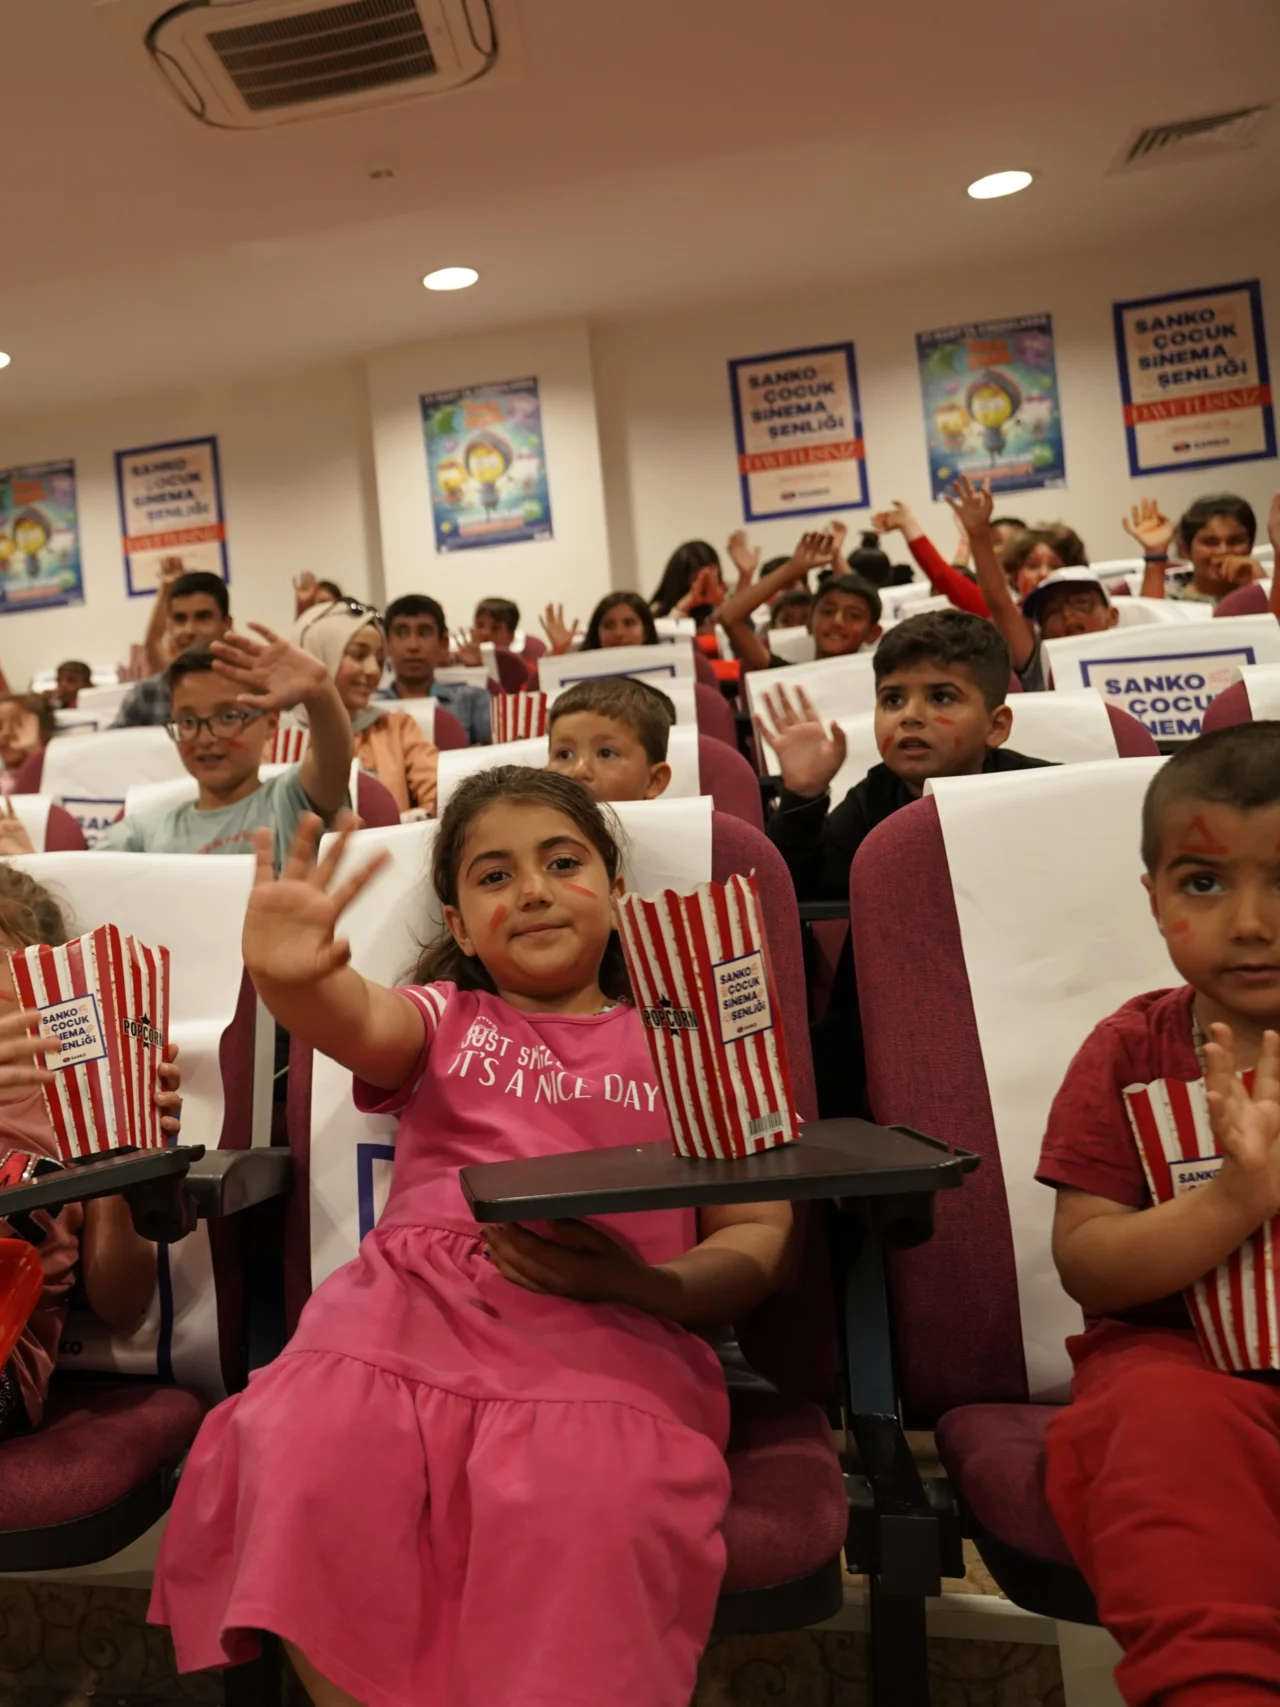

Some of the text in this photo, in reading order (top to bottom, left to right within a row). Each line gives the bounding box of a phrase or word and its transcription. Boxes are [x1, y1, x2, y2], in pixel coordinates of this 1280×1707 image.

[1135, 308, 1215, 334] SANKO
[1153, 322, 1237, 350] ÇOCUK
[748, 366, 817, 389] SANKO
[764, 382, 835, 404] ÇOCUK
[1105, 674, 1205, 695] SANKO
[1128, 695, 1217, 719] ÇOCU
[720, 966, 752, 985] SANKO
[728, 977, 761, 996] ÇOCUK
[42, 1007, 78, 1025] SANKO
[51, 1014, 90, 1035] ÇOCUK
[644, 1009, 698, 1028] POPCORN
[123, 1019, 164, 1048] POPCORN
[461, 1027, 513, 1057] JUST
[447, 1050, 660, 1112] IT'S A NICE DAY
